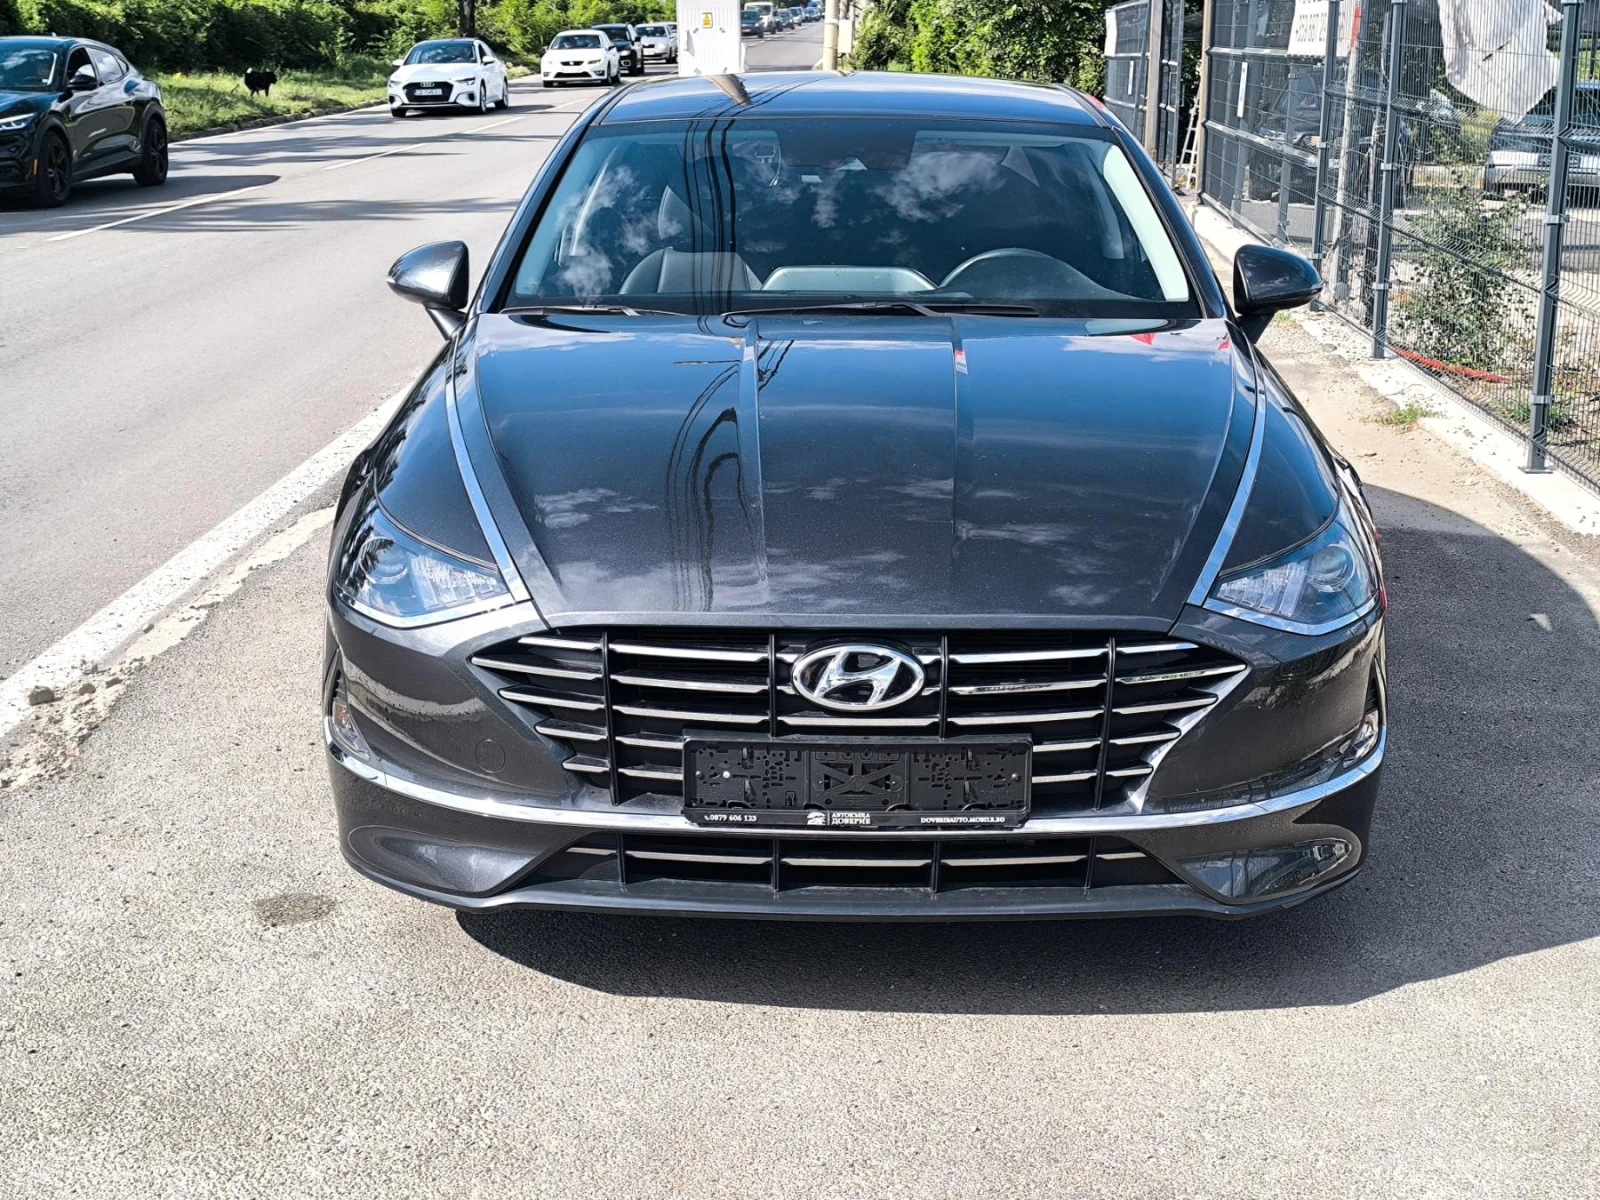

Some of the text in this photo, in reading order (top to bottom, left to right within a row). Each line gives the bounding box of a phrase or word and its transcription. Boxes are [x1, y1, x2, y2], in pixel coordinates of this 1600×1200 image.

[709, 814, 758, 822] 0879 606 123
[831, 817, 872, 826] ДОВЕРИЕ
